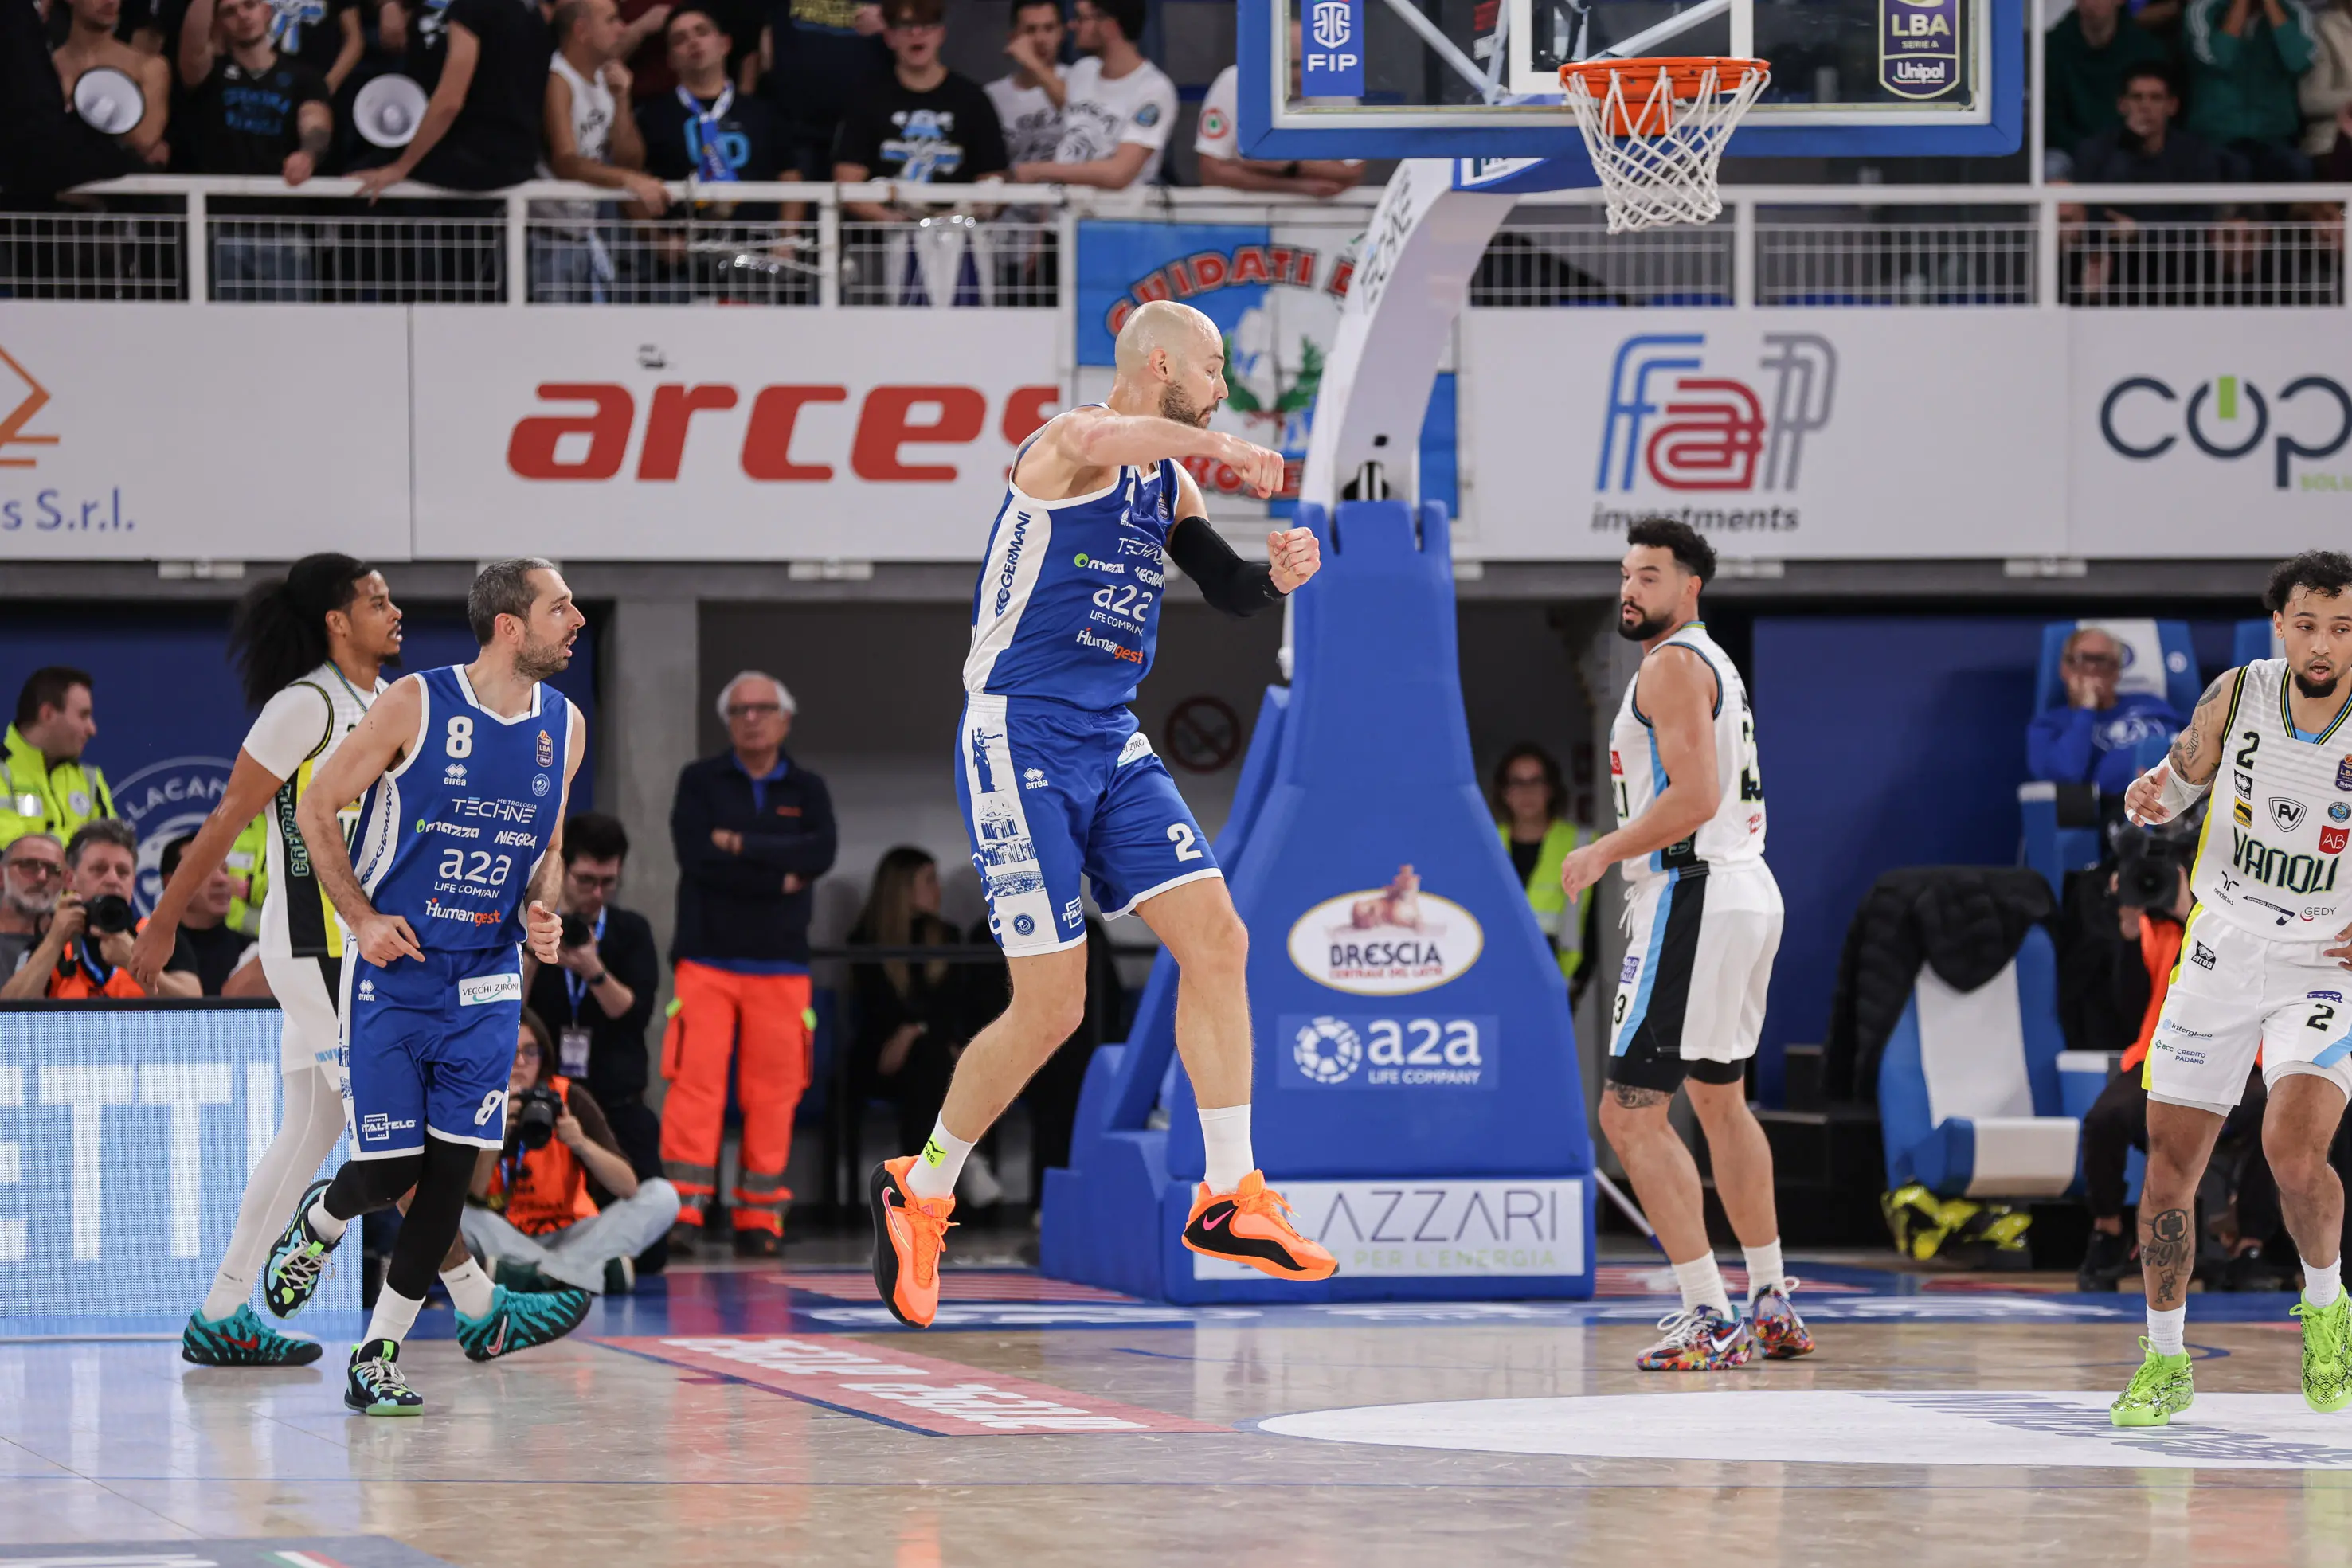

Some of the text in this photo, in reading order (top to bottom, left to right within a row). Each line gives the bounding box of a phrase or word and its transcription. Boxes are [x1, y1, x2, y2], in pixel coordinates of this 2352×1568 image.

[1892, 14, 1951, 37] LBA
[1901, 40, 1930, 49] SERIE
[1307, 53, 1358, 72] FIP
[1897, 61, 1945, 84] Unipol
[36, 487, 135, 531] S.r.l.
[1000, 510, 1031, 588] GERMANI
[1092, 585, 1153, 622] a2a
[1090, 609, 1144, 637] LIFE COMPAN
[1075, 627, 1144, 664] Humangest
[446, 715, 474, 759] 8
[2236, 730, 2260, 770] 2
[444, 777, 467, 787] errea
[1025, 778, 1048, 790] errea
[2340, 768, 2352, 777] LB
[452, 796, 537, 824] TECHNE
[497, 797, 538, 811] METROLOGIA
[376, 782, 393, 858] GERMANI
[1166, 823, 1203, 862] 2
[439, 849, 512, 886] a2a
[2233, 825, 2341, 895] VANOLI
[434, 881, 500, 899] LIFE COMPAN
[2214, 888, 2233, 905] randstad
[425, 898, 502, 927] Humangest
[2304, 907, 2337, 916] GEDY
[1331, 942, 1442, 966] BRESCIA
[2193, 955, 2214, 970] errea
[462, 985, 491, 996] VECCHI
[2307, 1003, 2334, 1031] 2
[1368, 1019, 1482, 1066] a2a
[2162, 1043, 2206, 1058] BCC CREDITO
[2175, 1055, 2205, 1065] PADANO
[1368, 1069, 1482, 1085] LIFE COMPANY
[474, 1089, 504, 1127] 8
[1356, 1249, 1557, 1269] PER L'ENERGIA
